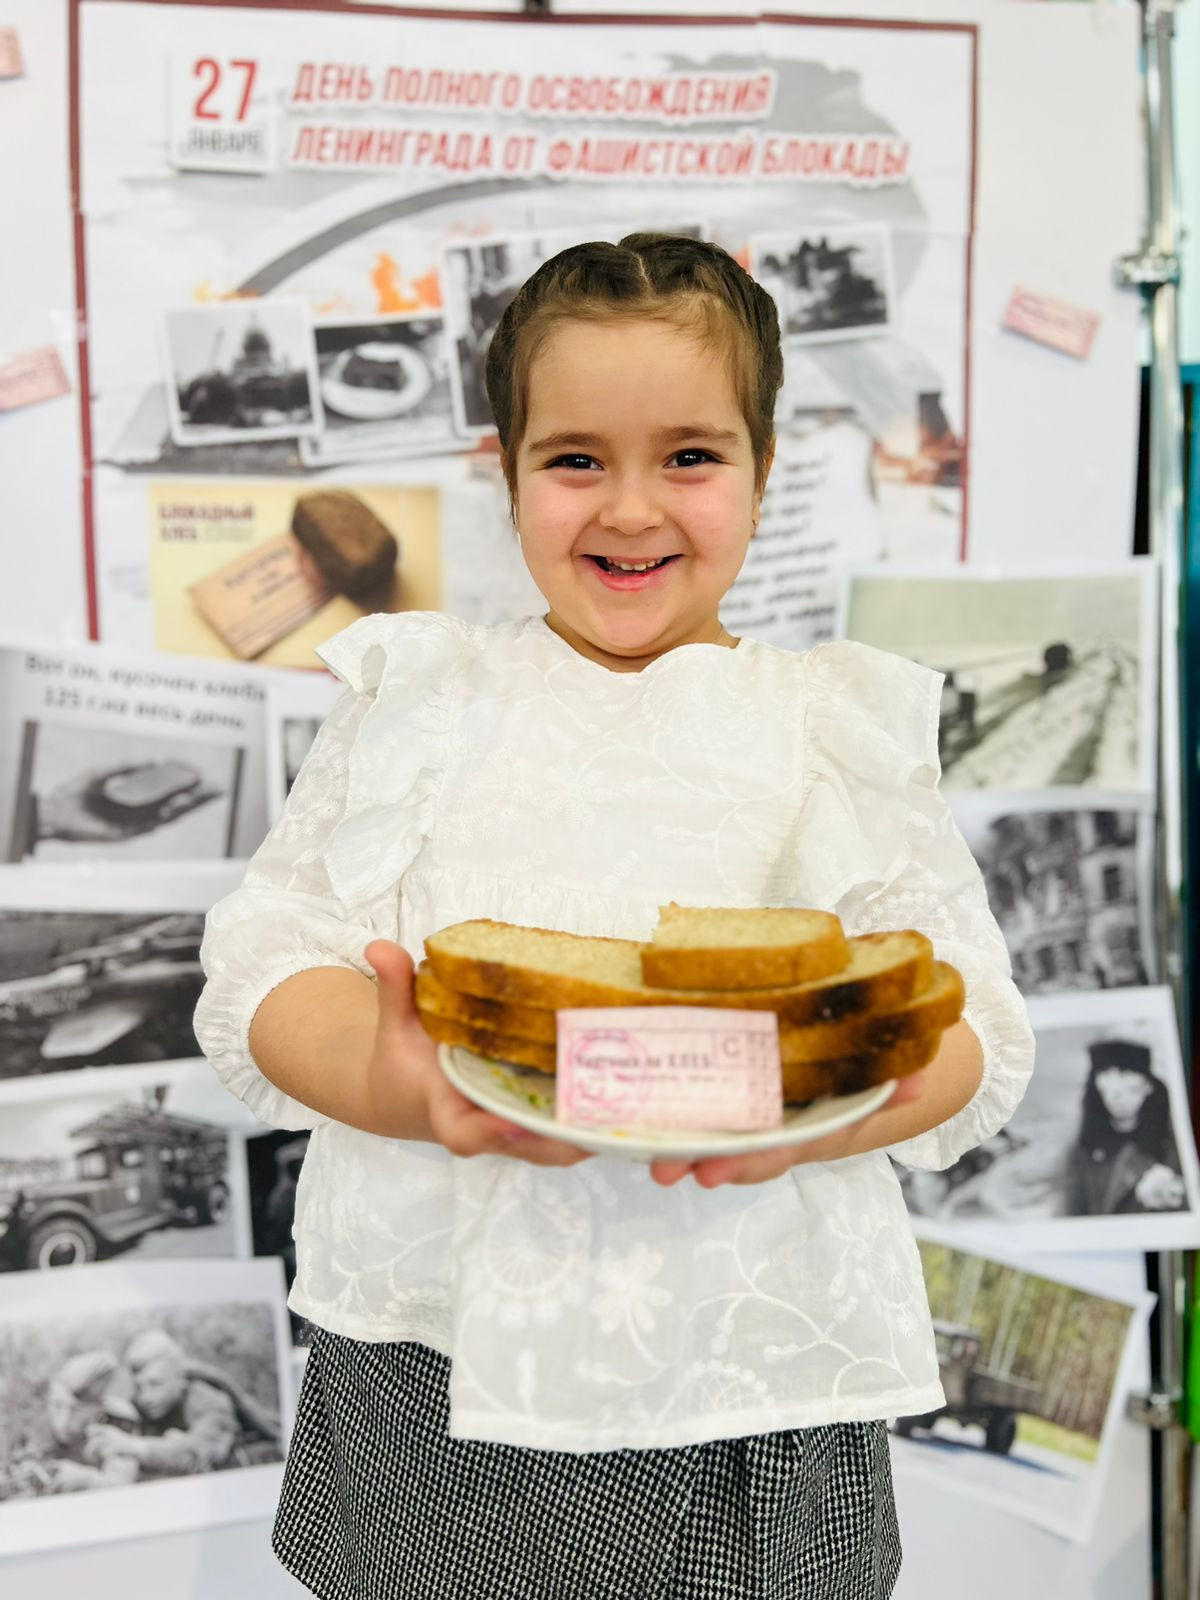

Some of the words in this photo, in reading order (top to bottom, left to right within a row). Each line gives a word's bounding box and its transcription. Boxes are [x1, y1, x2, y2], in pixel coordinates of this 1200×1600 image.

[194, 57, 258, 121] 27
[293, 63, 374, 102] ДЕНЬ
[384, 67, 519, 108] ПОЛНОГО
[529, 75, 770, 116] ОСВОБОЖДЕНИЯ
[293, 127, 491, 171] ЛЕНИНГРАДА
[505, 137, 536, 171] ОТ
[547, 135, 756, 178] ФАШИСТСКОЙ
[762, 139, 908, 179] БЛОКАДЫ
